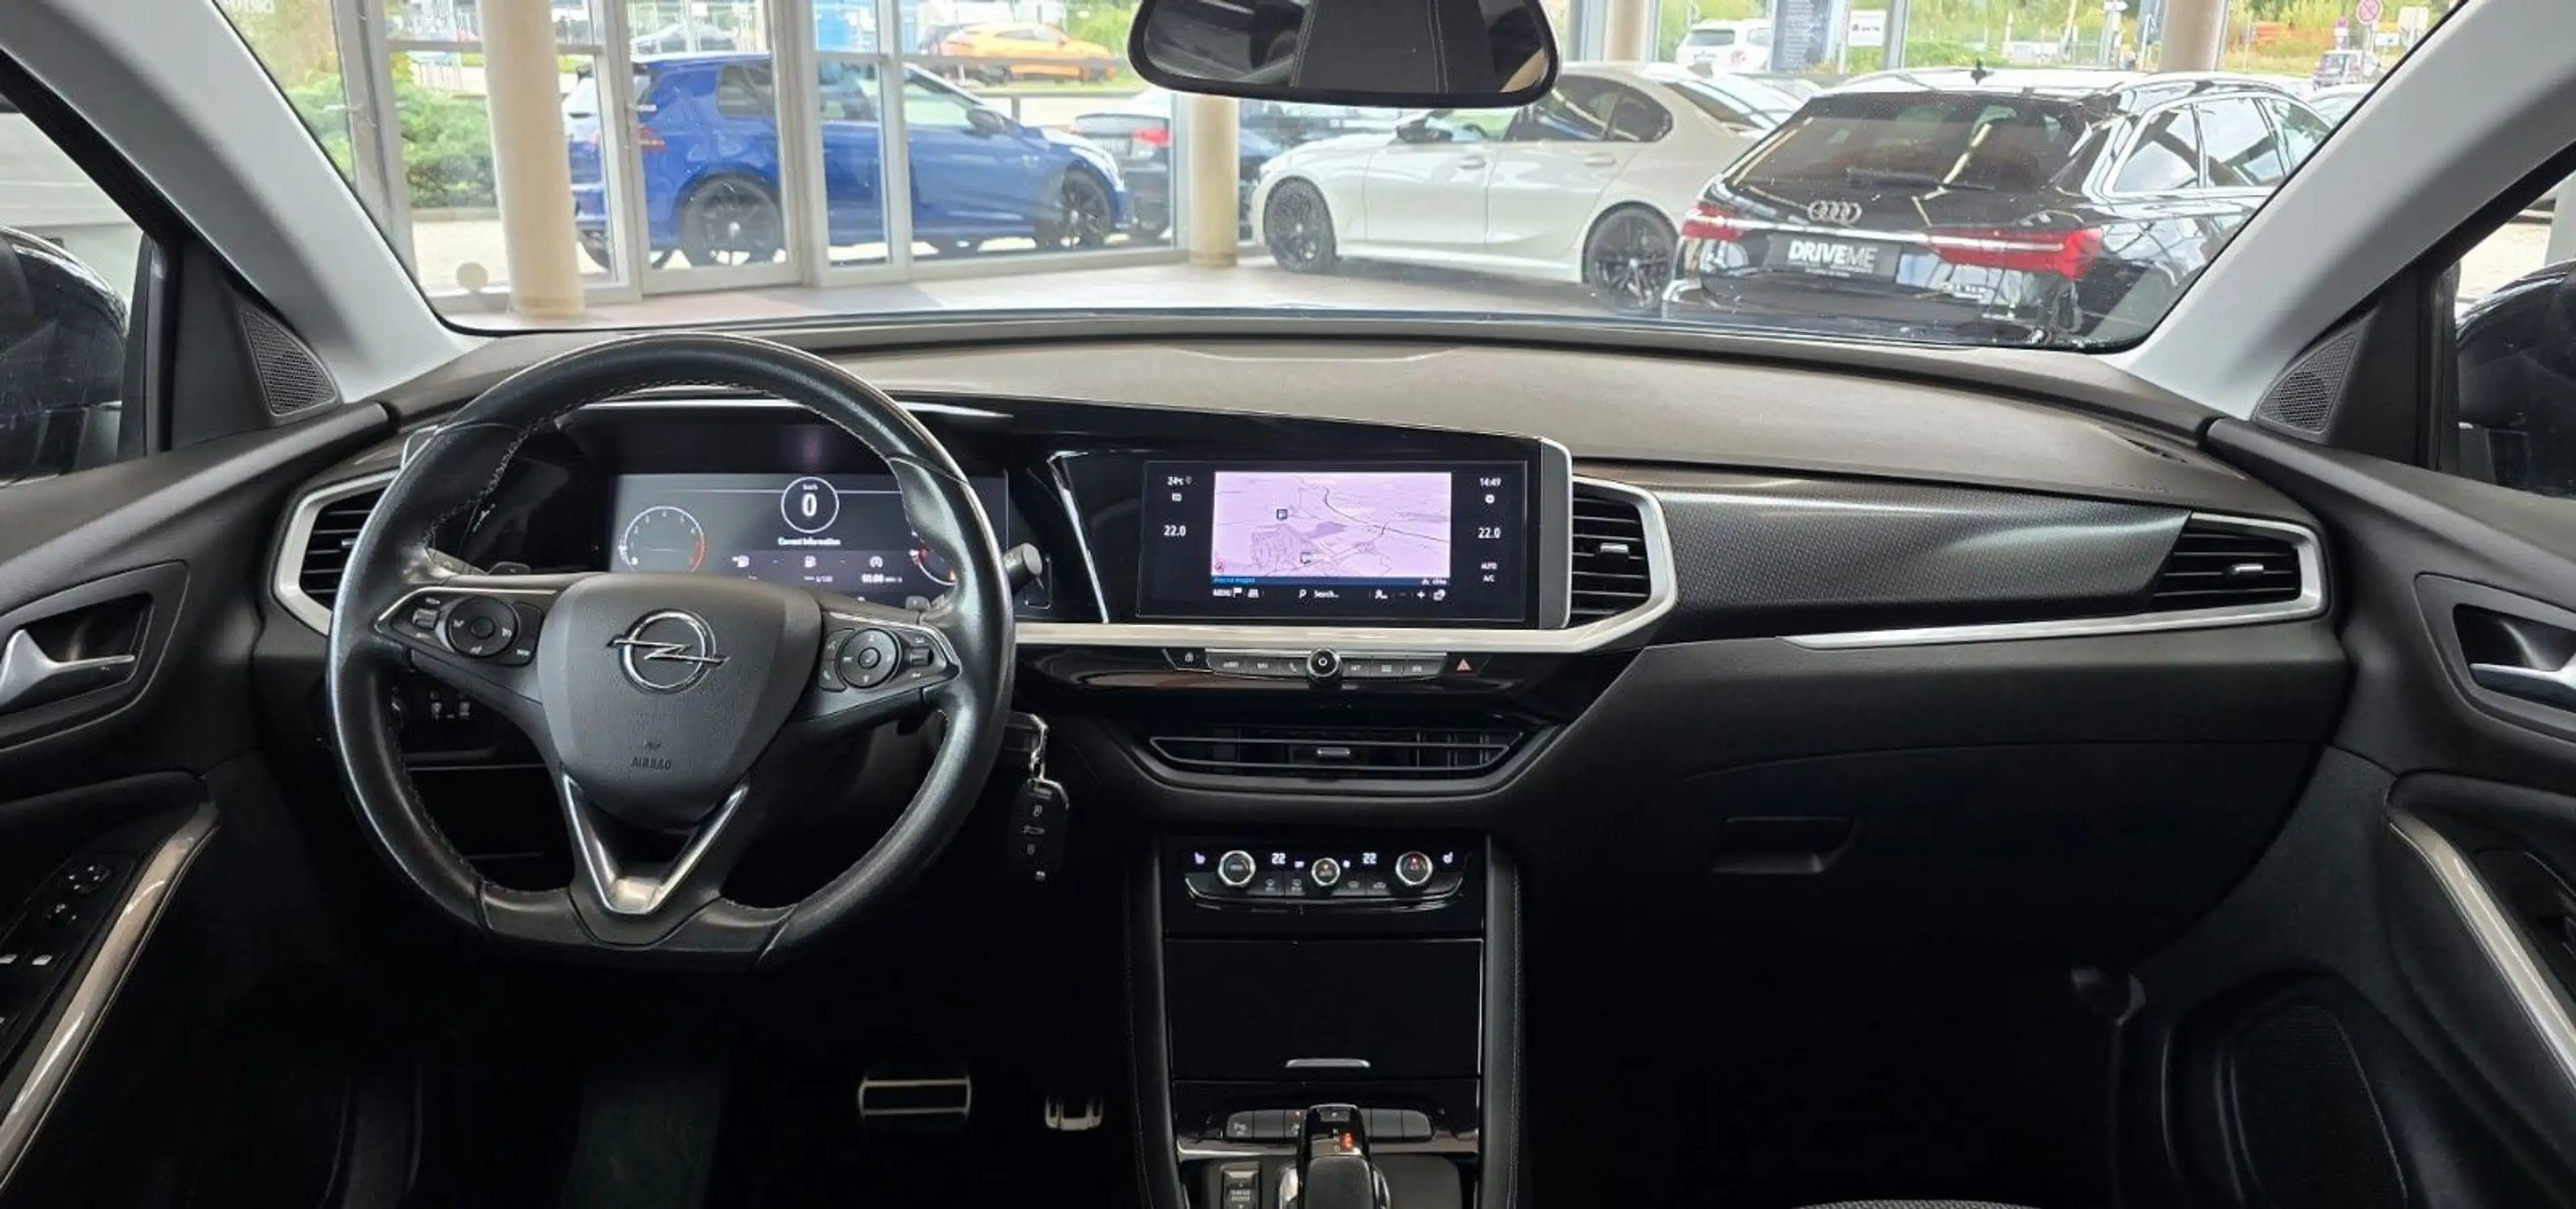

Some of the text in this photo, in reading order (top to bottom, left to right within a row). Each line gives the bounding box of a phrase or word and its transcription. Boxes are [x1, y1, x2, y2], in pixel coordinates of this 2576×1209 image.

[1479, 478, 1502, 487] 14:49
[802, 493, 817, 517] 0
[1164, 525, 1186, 537] 22.0
[1478, 527, 1501, 539] 22.0
[777, 537, 841, 545] Current Information
[1271, 853, 1286, 865] 22
[1362, 852, 1377, 865] 22
